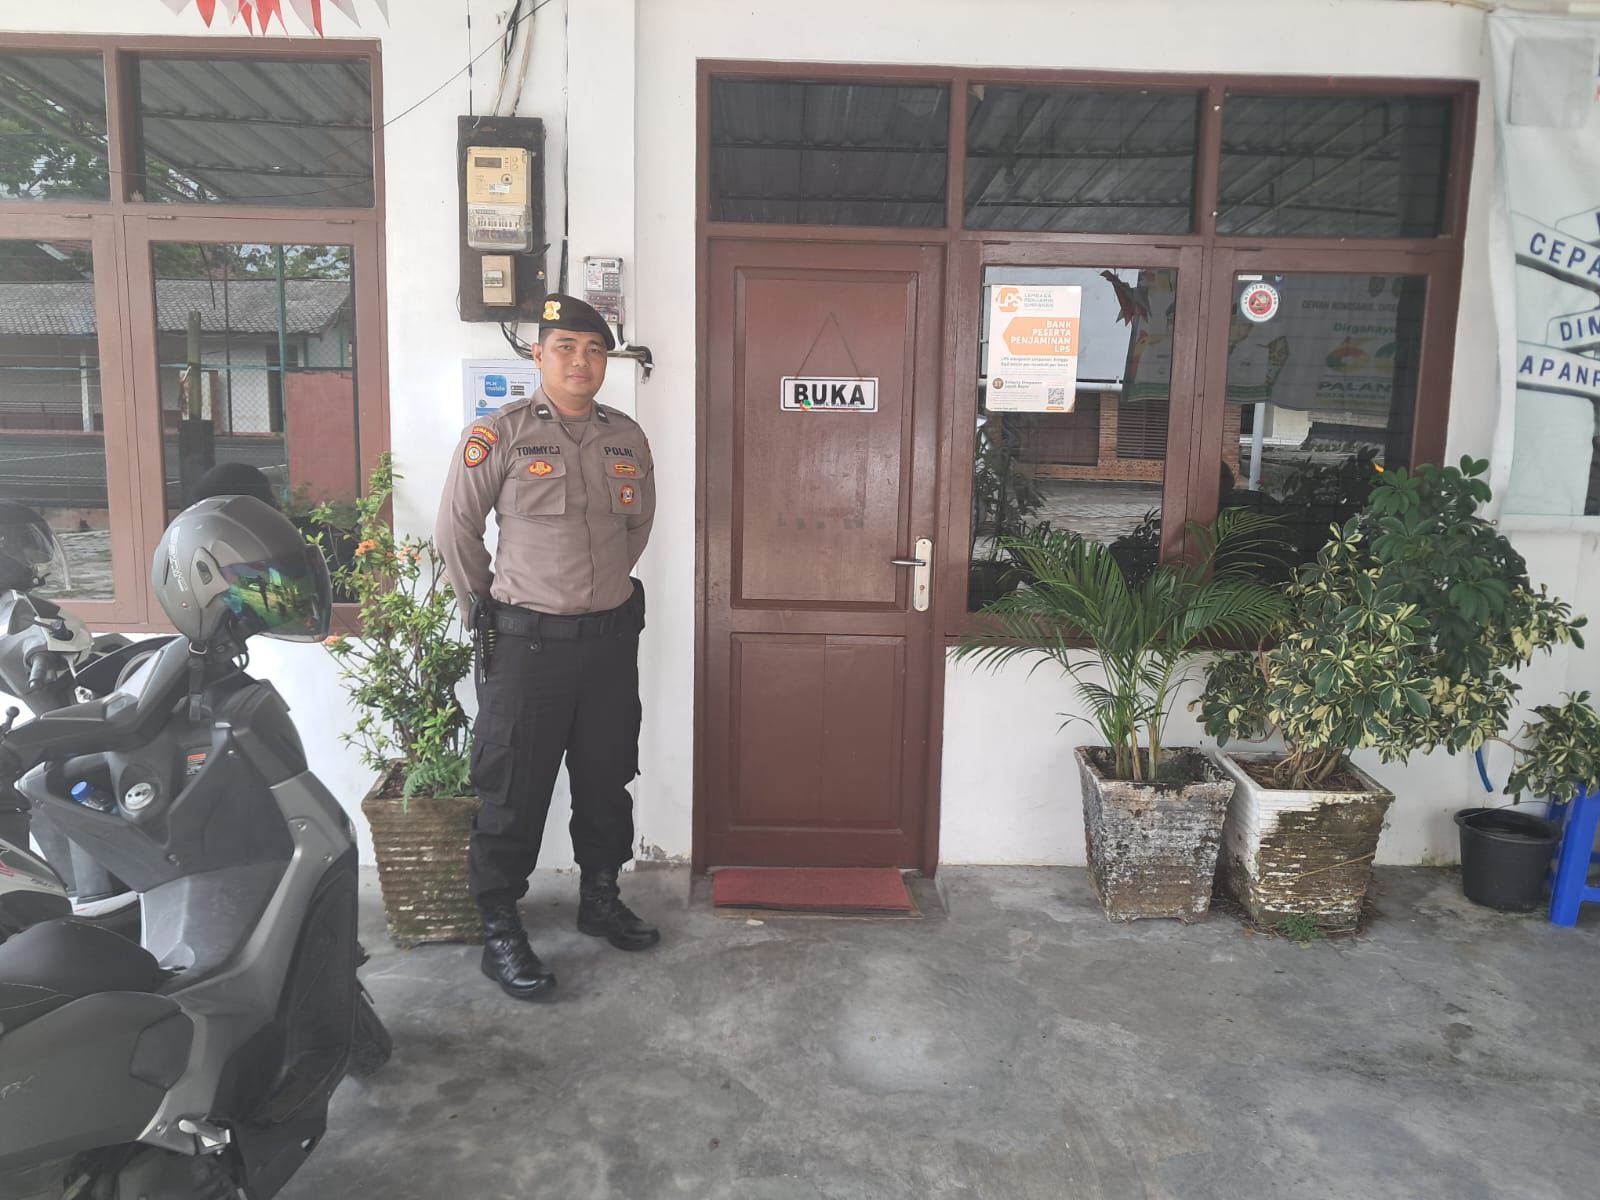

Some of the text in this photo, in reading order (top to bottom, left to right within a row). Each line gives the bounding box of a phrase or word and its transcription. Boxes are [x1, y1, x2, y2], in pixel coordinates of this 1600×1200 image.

[1046, 320, 1072, 329] BANK
[1032, 328, 1071, 337] PESERTA
[1010, 336, 1071, 345] PENJAMINAN
[1054, 344, 1071, 353] LPS
[794, 383, 865, 406] BUKA
[604, 446, 634, 458] POLRI
